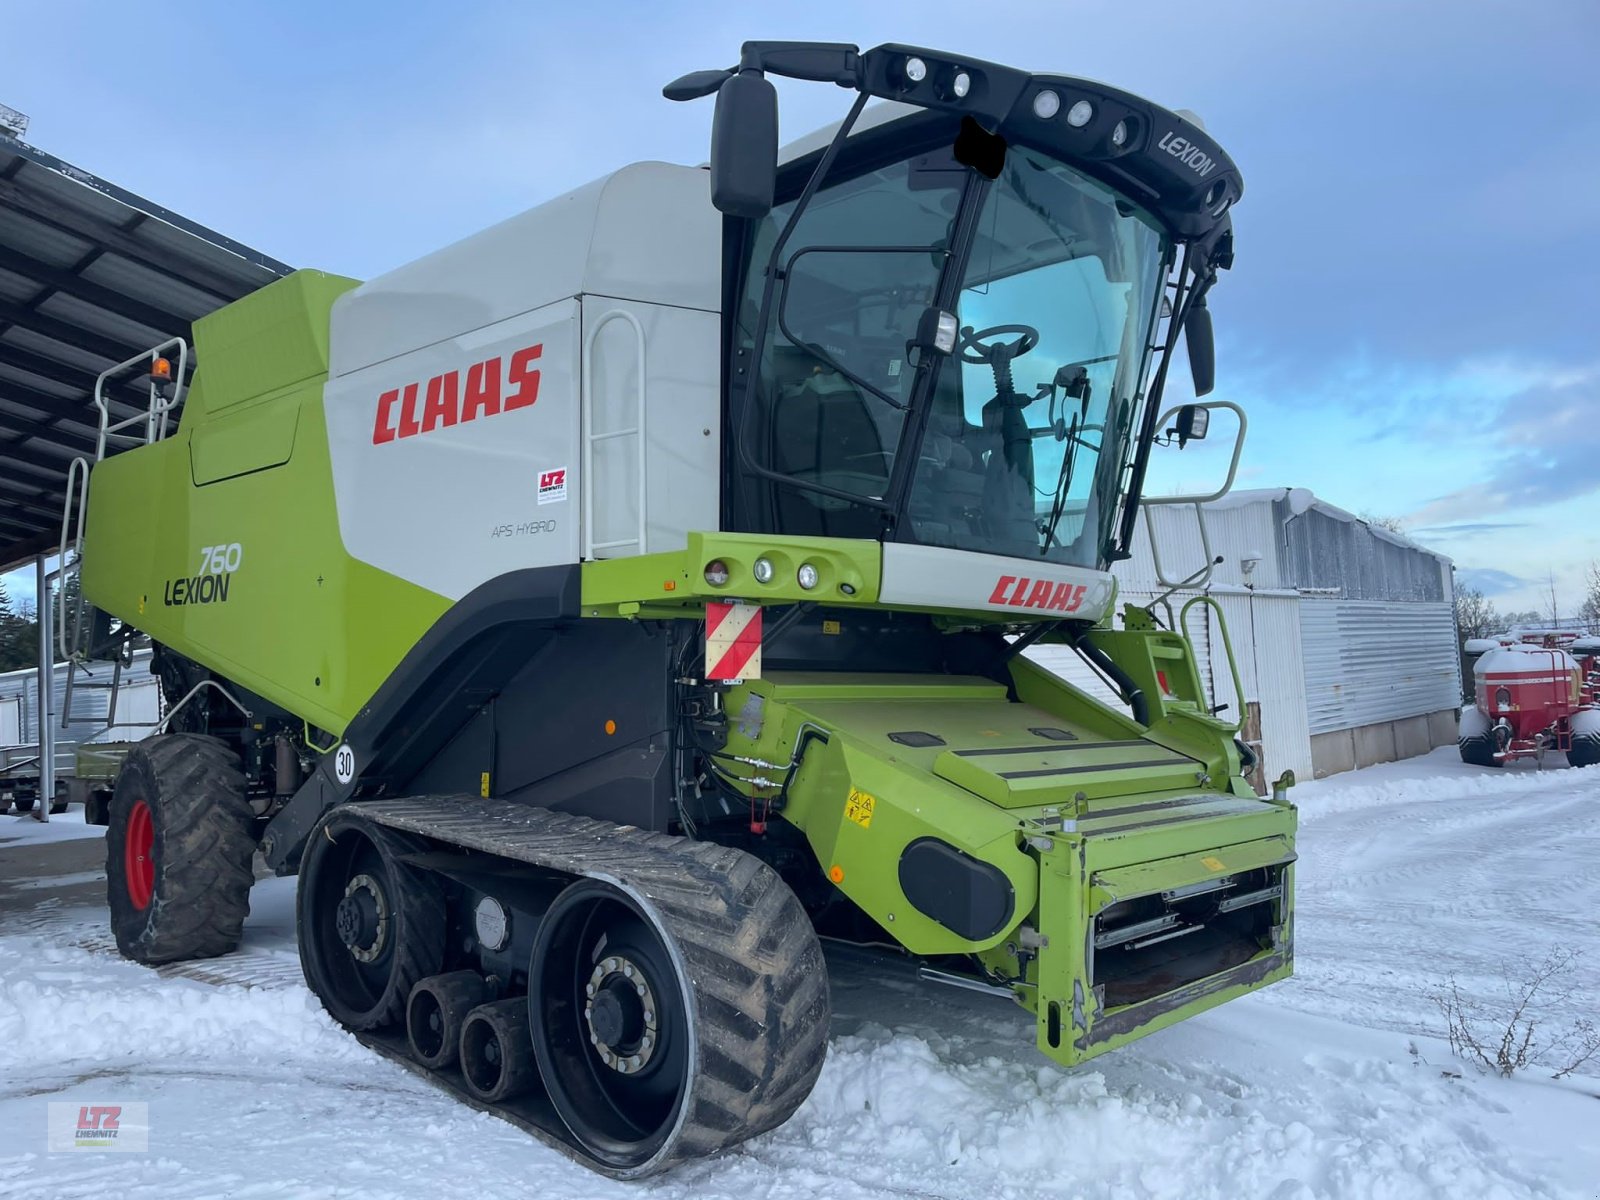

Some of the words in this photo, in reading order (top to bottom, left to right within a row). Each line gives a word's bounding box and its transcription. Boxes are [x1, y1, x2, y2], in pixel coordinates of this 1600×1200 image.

[1158, 131, 1217, 177] LEXION
[372, 343, 543, 445] CLAAS
[540, 470, 565, 488] LTZ
[491, 524, 513, 538] APS
[516, 519, 557, 536] HYBRID
[198, 542, 242, 576] 760
[164, 573, 231, 606] LEXION
[988, 575, 1088, 612] CLAAS
[338, 752, 351, 776] 30
